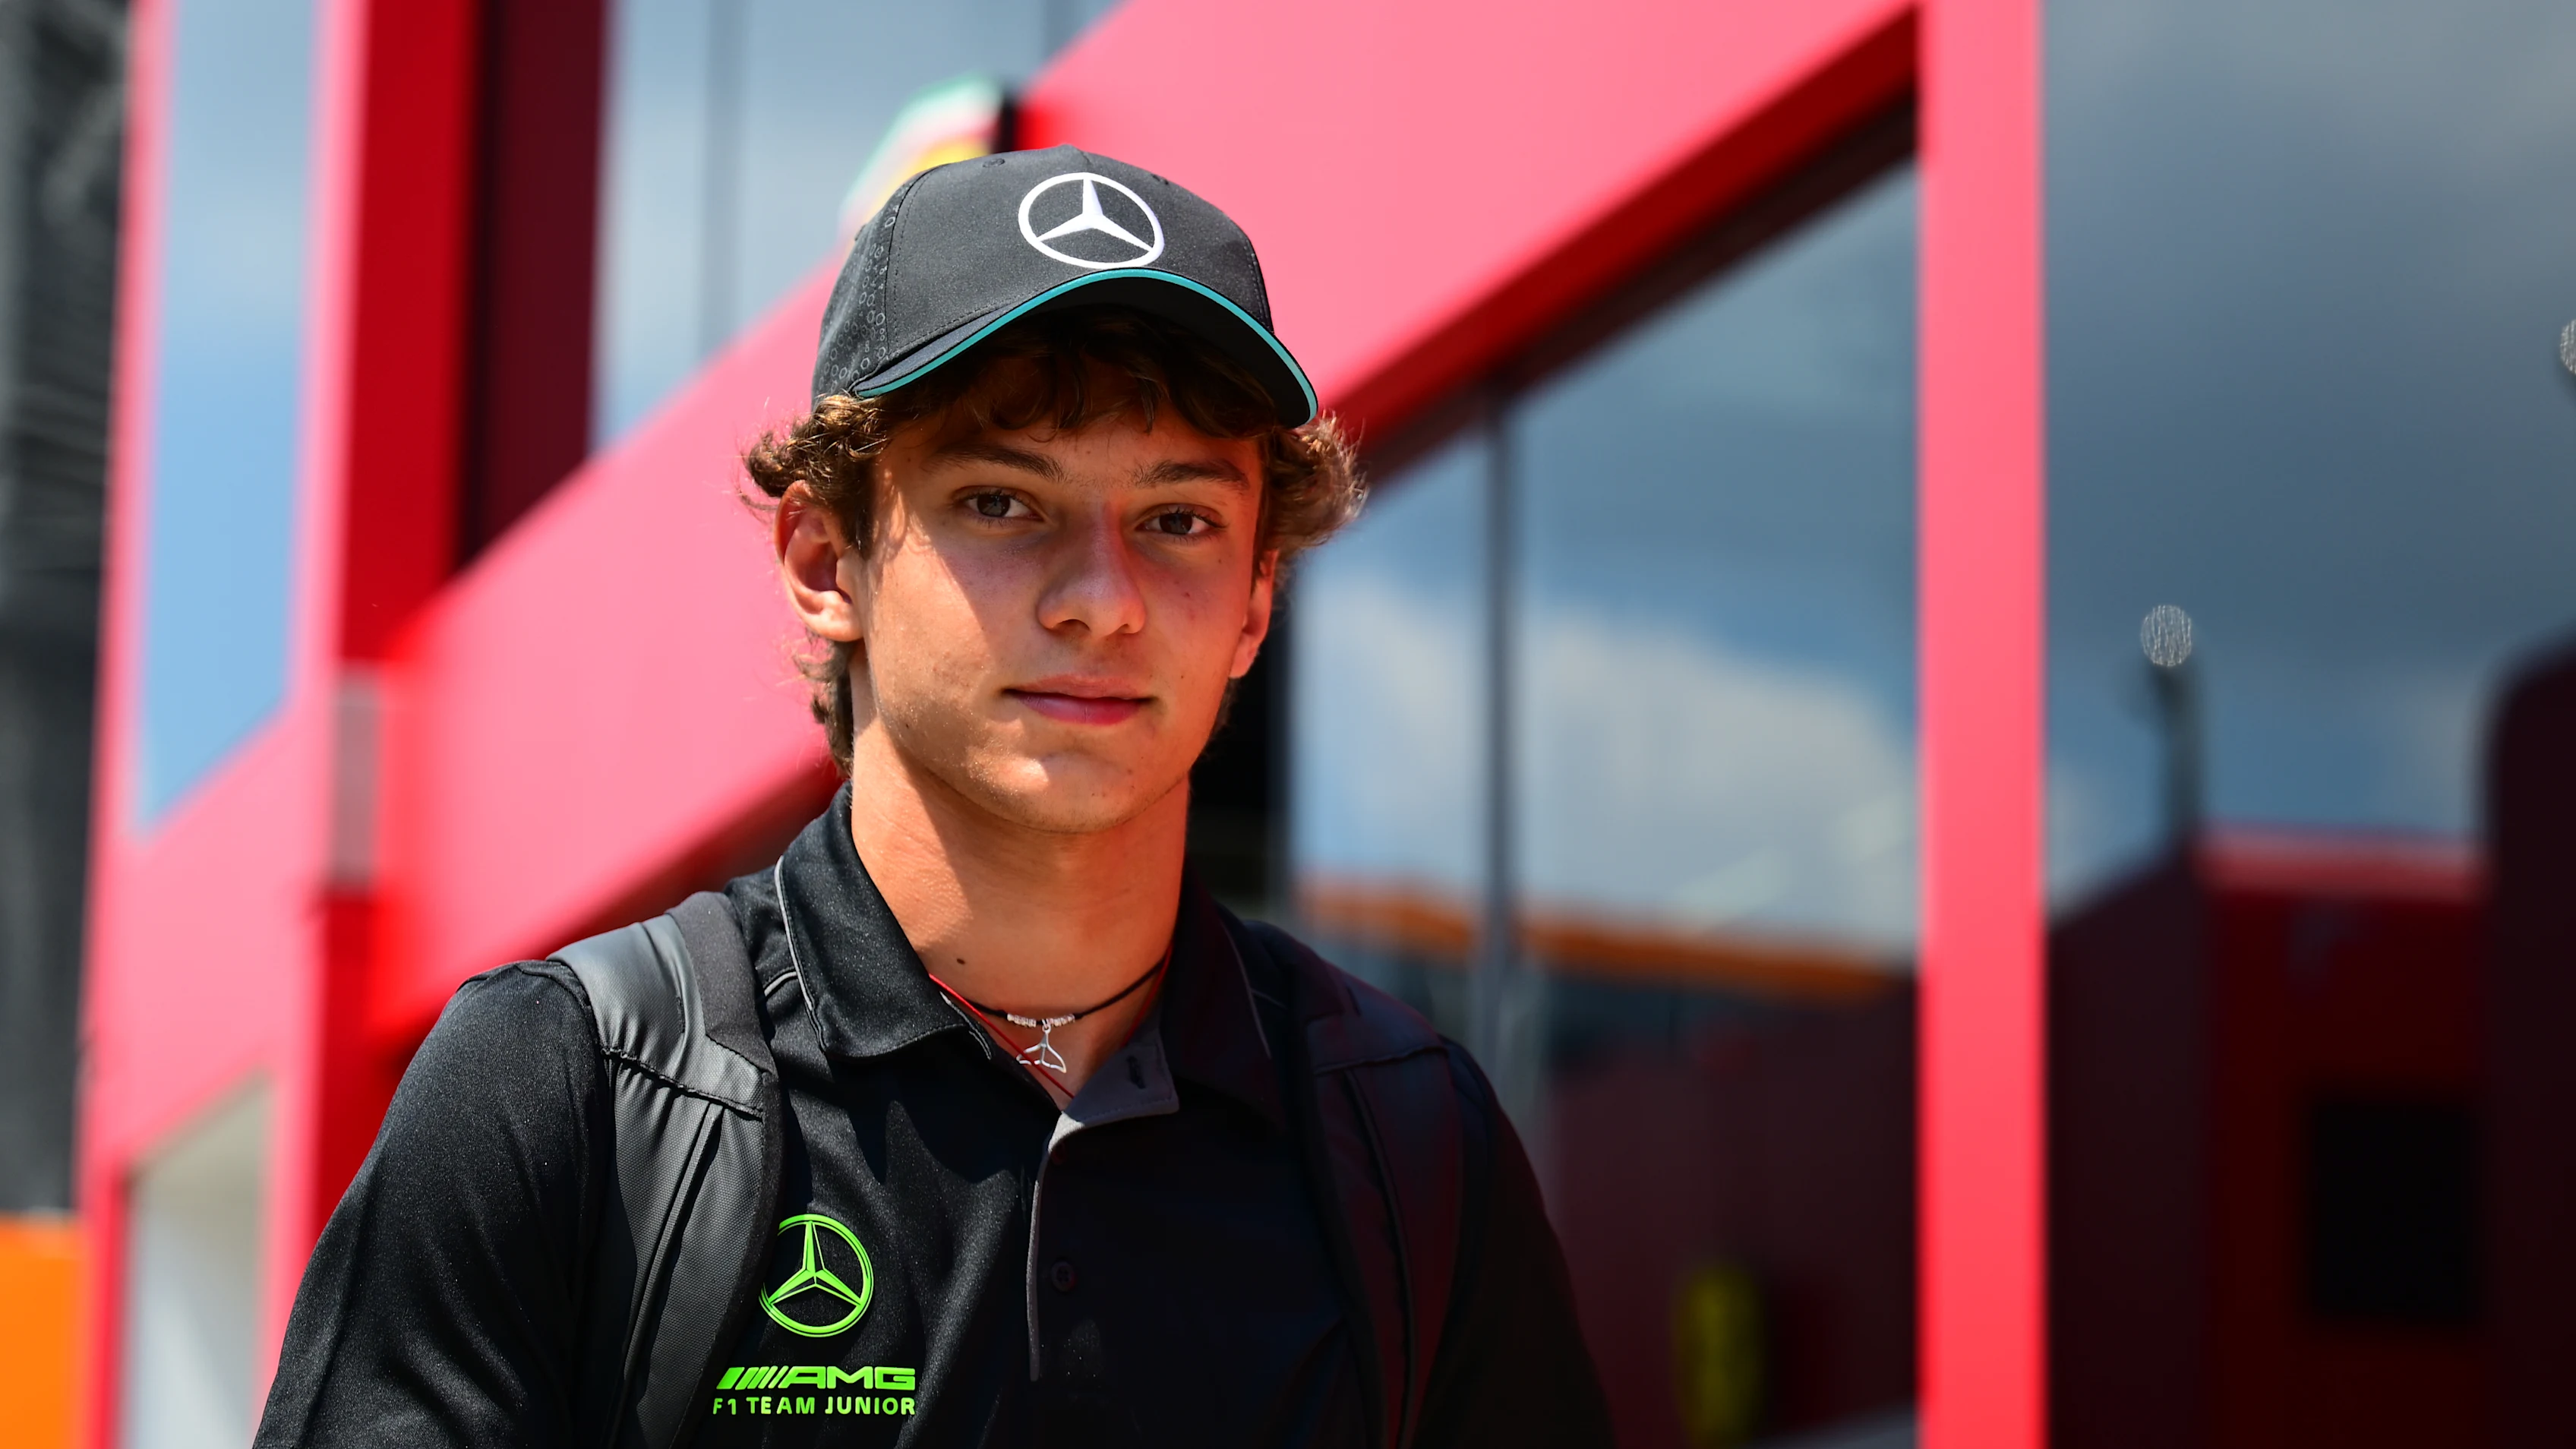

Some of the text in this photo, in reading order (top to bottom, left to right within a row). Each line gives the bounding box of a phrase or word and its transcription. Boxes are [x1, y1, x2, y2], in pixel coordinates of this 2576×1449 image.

[777, 1365, 916, 1391] AMG
[712, 1395, 917, 1416] F1 TEAM JUNIOR
